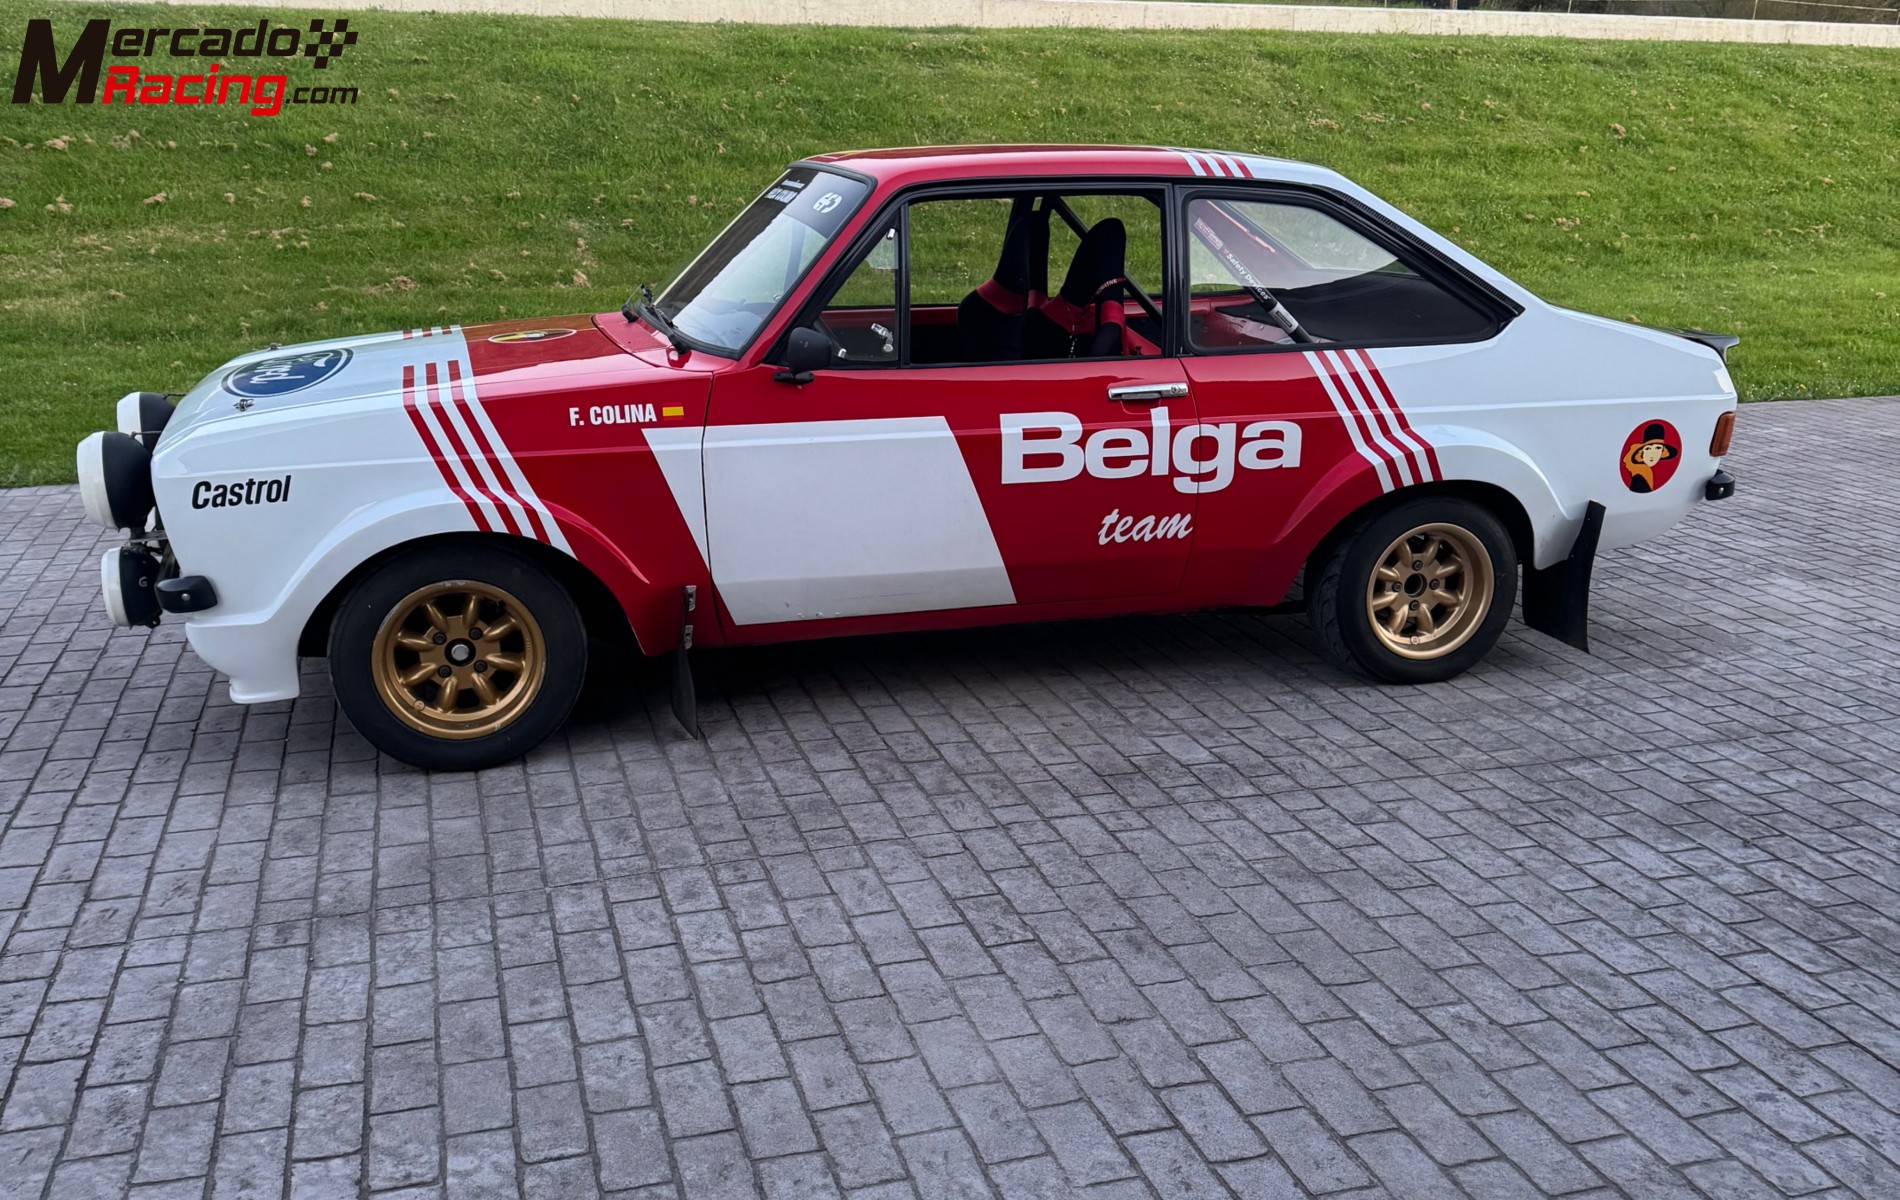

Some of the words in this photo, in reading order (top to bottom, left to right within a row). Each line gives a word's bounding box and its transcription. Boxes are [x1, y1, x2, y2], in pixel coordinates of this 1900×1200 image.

[1226, 253, 1247, 275] Safety
[1244, 274, 1271, 300] Devices
[569, 407, 584, 426] F.
[589, 403, 657, 425] COLINA
[1000, 406, 1302, 494] Belga
[192, 474, 292, 509] Castrol
[1098, 508, 1193, 546] team
